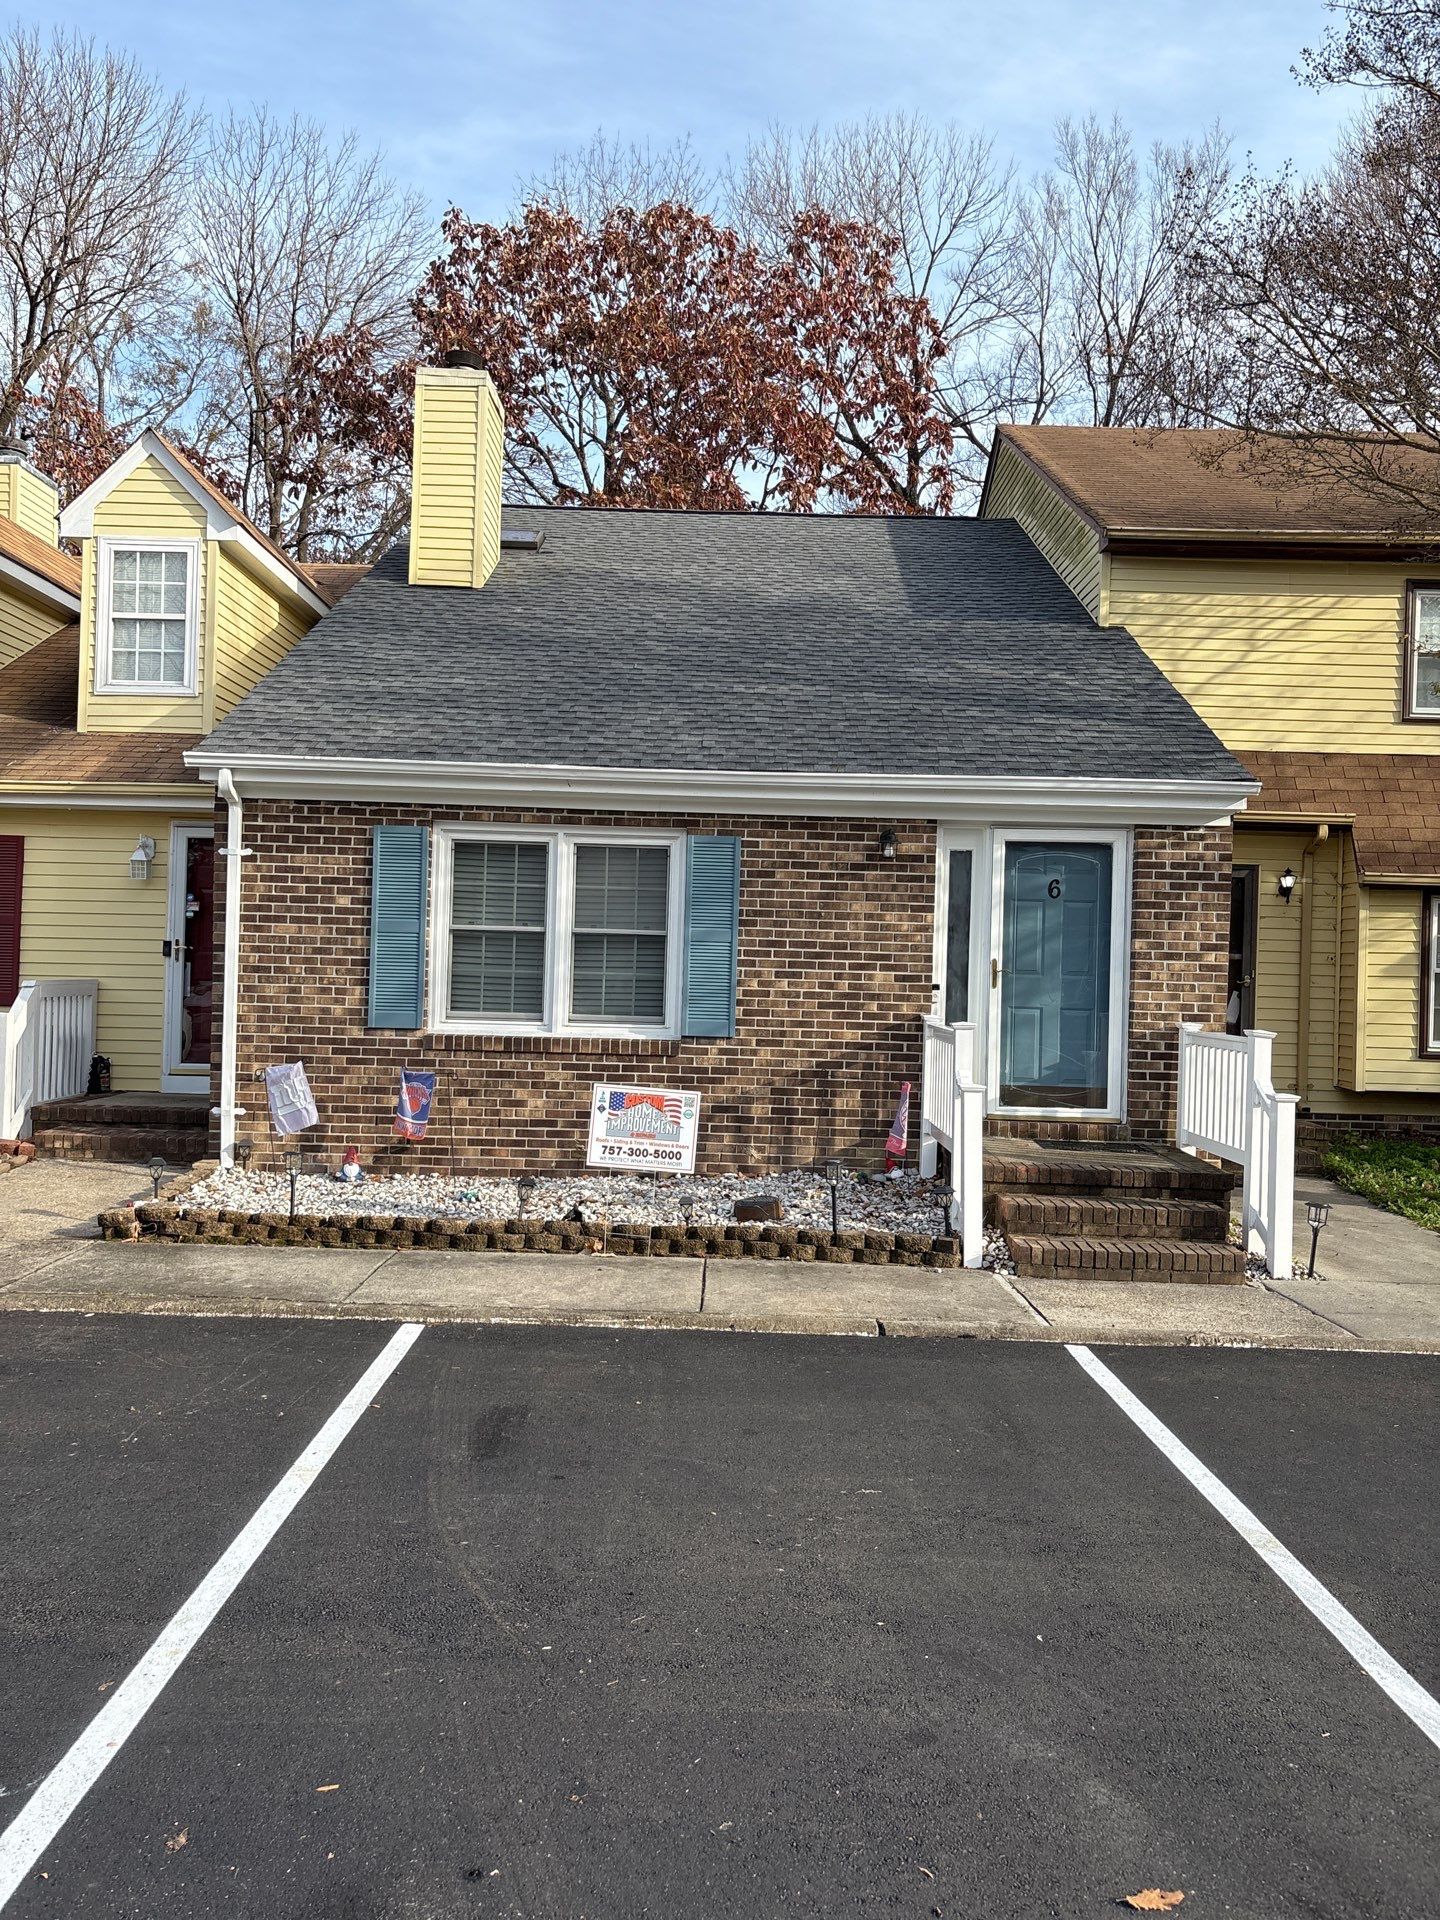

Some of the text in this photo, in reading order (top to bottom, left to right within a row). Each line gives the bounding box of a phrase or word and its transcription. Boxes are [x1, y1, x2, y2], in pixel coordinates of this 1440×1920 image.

[1048, 879, 1061, 899] 6
[627, 1105, 658, 1120] HOME
[607, 1117, 679, 1135] IMPROVEMENT
[601, 1145, 682, 1161] 757-300-5000
